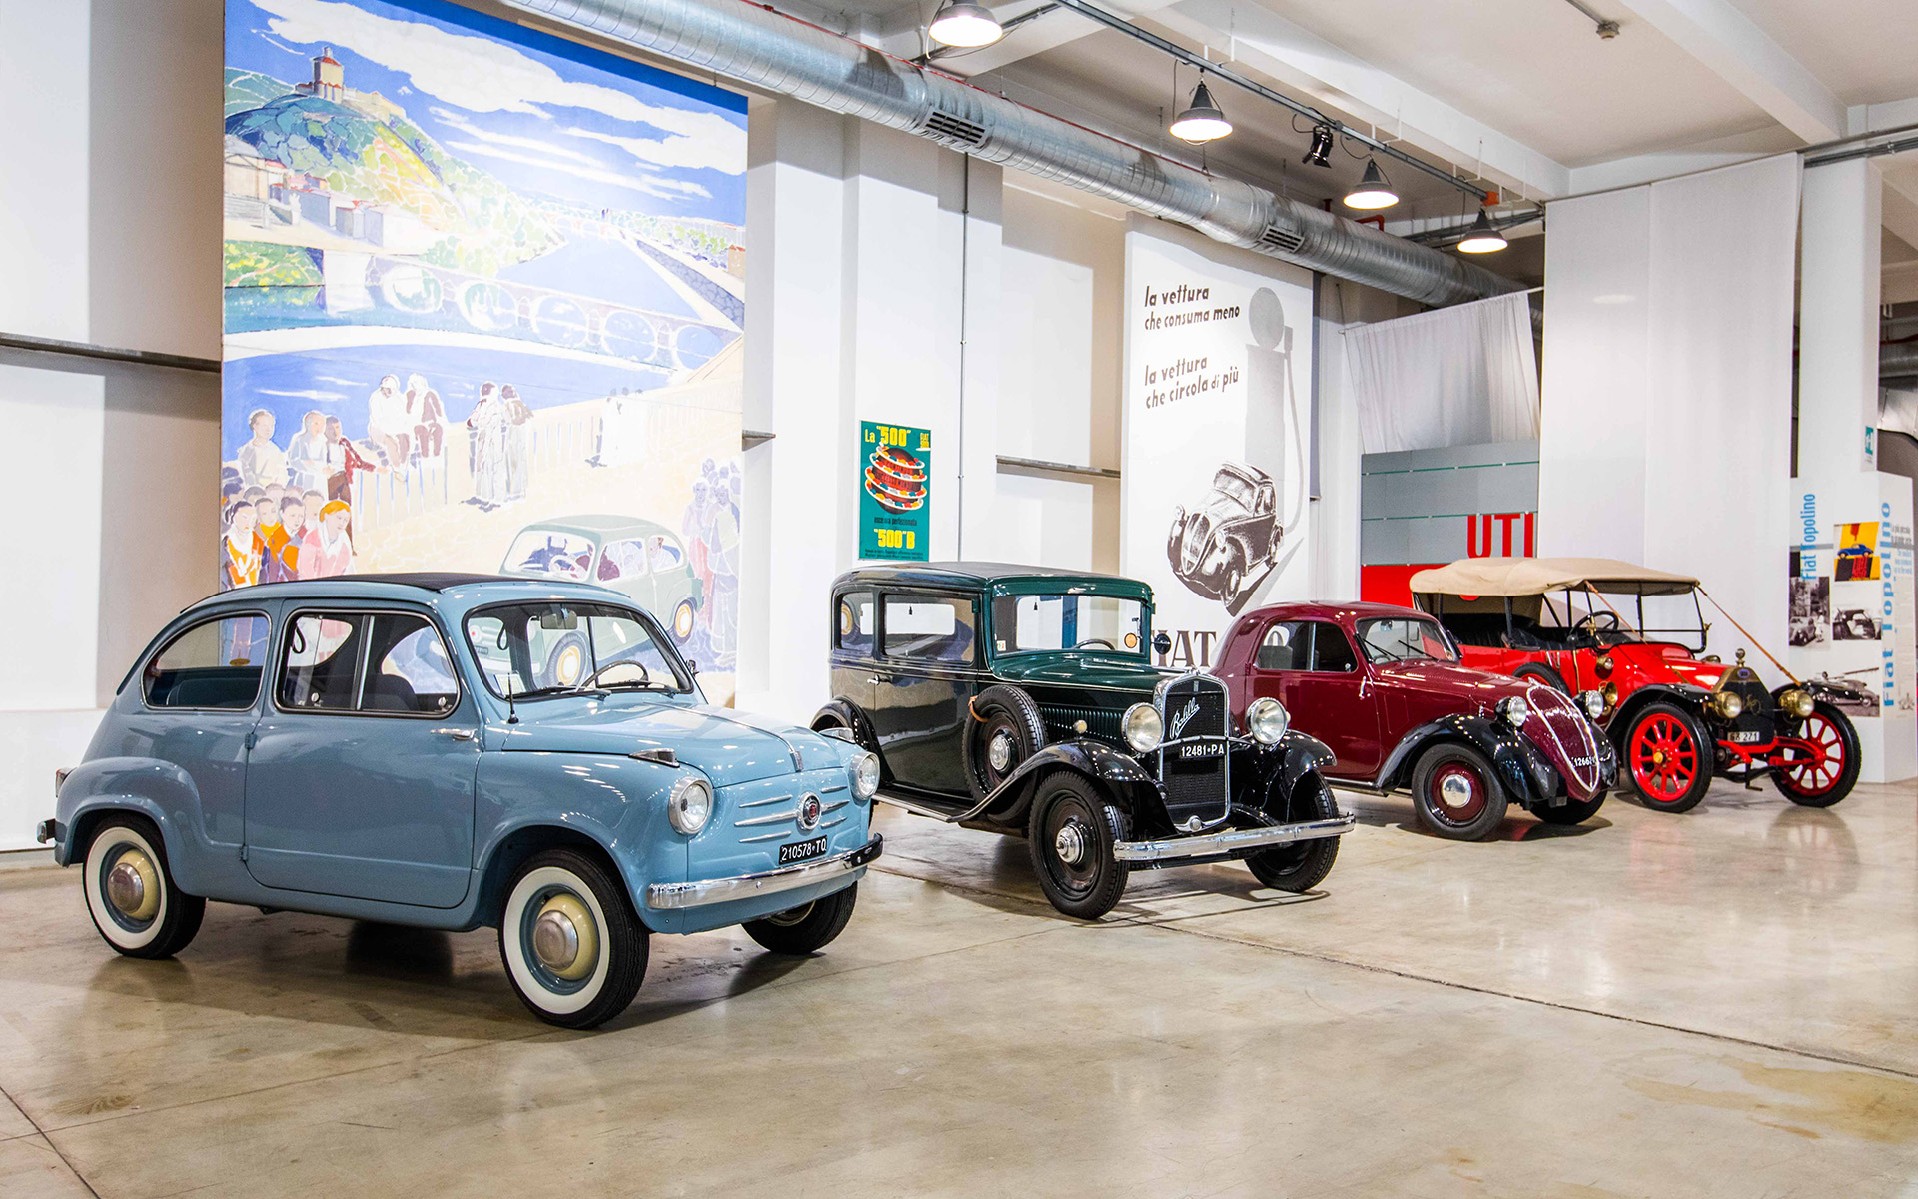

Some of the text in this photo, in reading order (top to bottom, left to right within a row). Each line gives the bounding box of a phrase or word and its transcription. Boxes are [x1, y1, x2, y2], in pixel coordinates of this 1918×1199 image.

[1144, 285, 1209, 307] la vettura
[1145, 305, 1240, 331] che consuma meno
[1144, 356, 1208, 386] la vettura
[1146, 366, 1239, 409] che circola di più
[864, 428, 875, 443] La
[1800, 493, 1819, 580] Fiat Topolino
